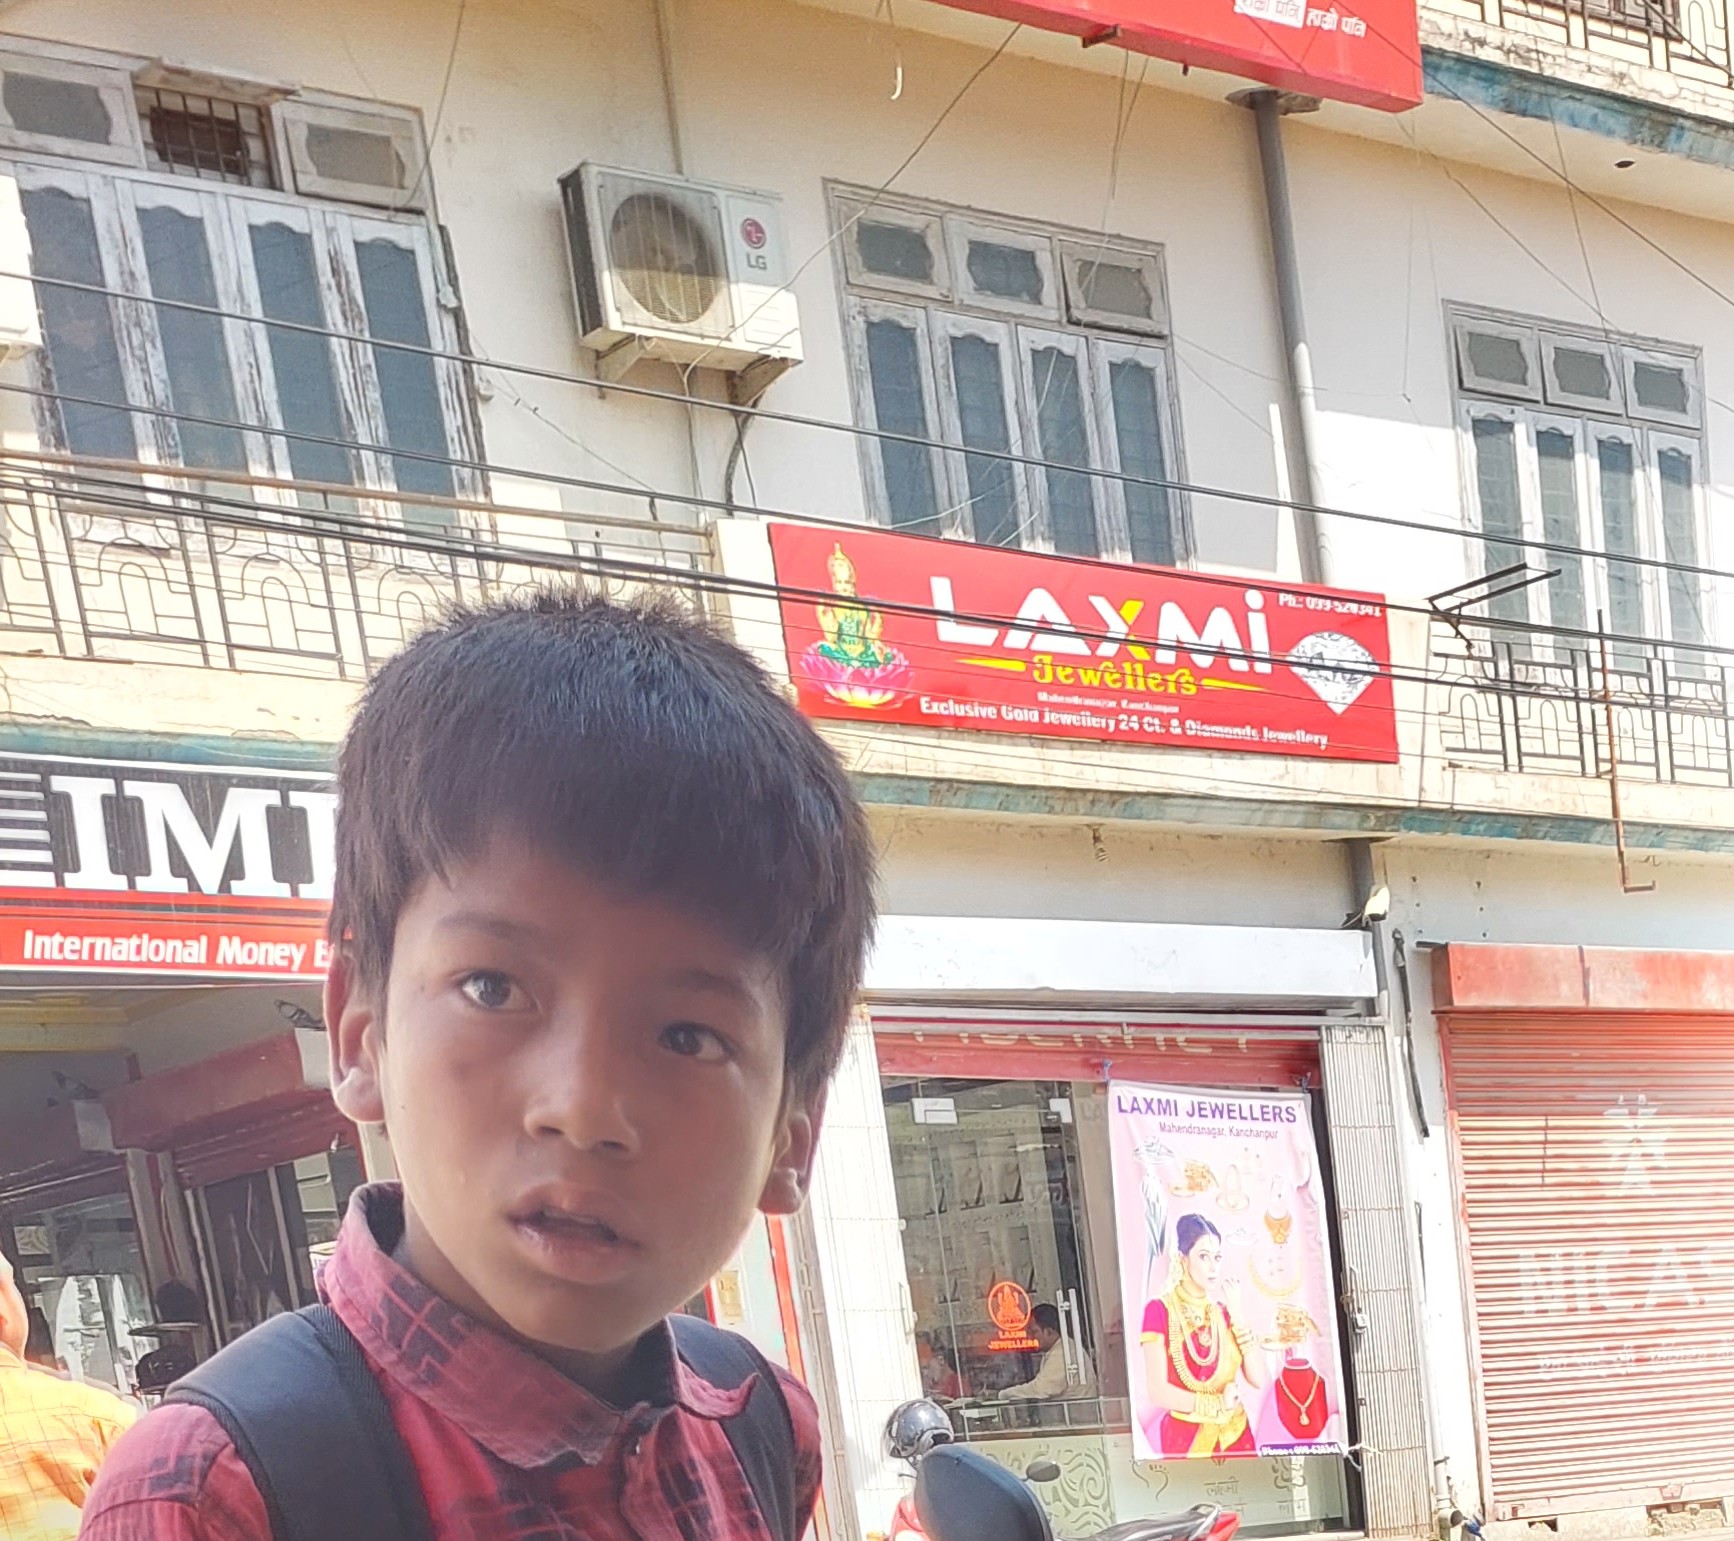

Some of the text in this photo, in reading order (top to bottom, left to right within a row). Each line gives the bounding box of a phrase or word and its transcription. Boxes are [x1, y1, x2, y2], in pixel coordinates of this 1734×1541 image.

[746, 253, 768, 271] LG
[1032, 654, 1199, 695] Jewellers
[919, 696, 997, 720] Exclusive
[1001, 705, 1040, 723] Gold
[1118, 713, 1140, 731] 24
[1169, 719, 1183, 735] &
[24, 929, 208, 964] International
[216, 936, 307, 971] Money
[1116, 1095, 1297, 1123] LAXMI JEWELLERS
[1229, 1126, 1279, 1141] Kanchanpur
